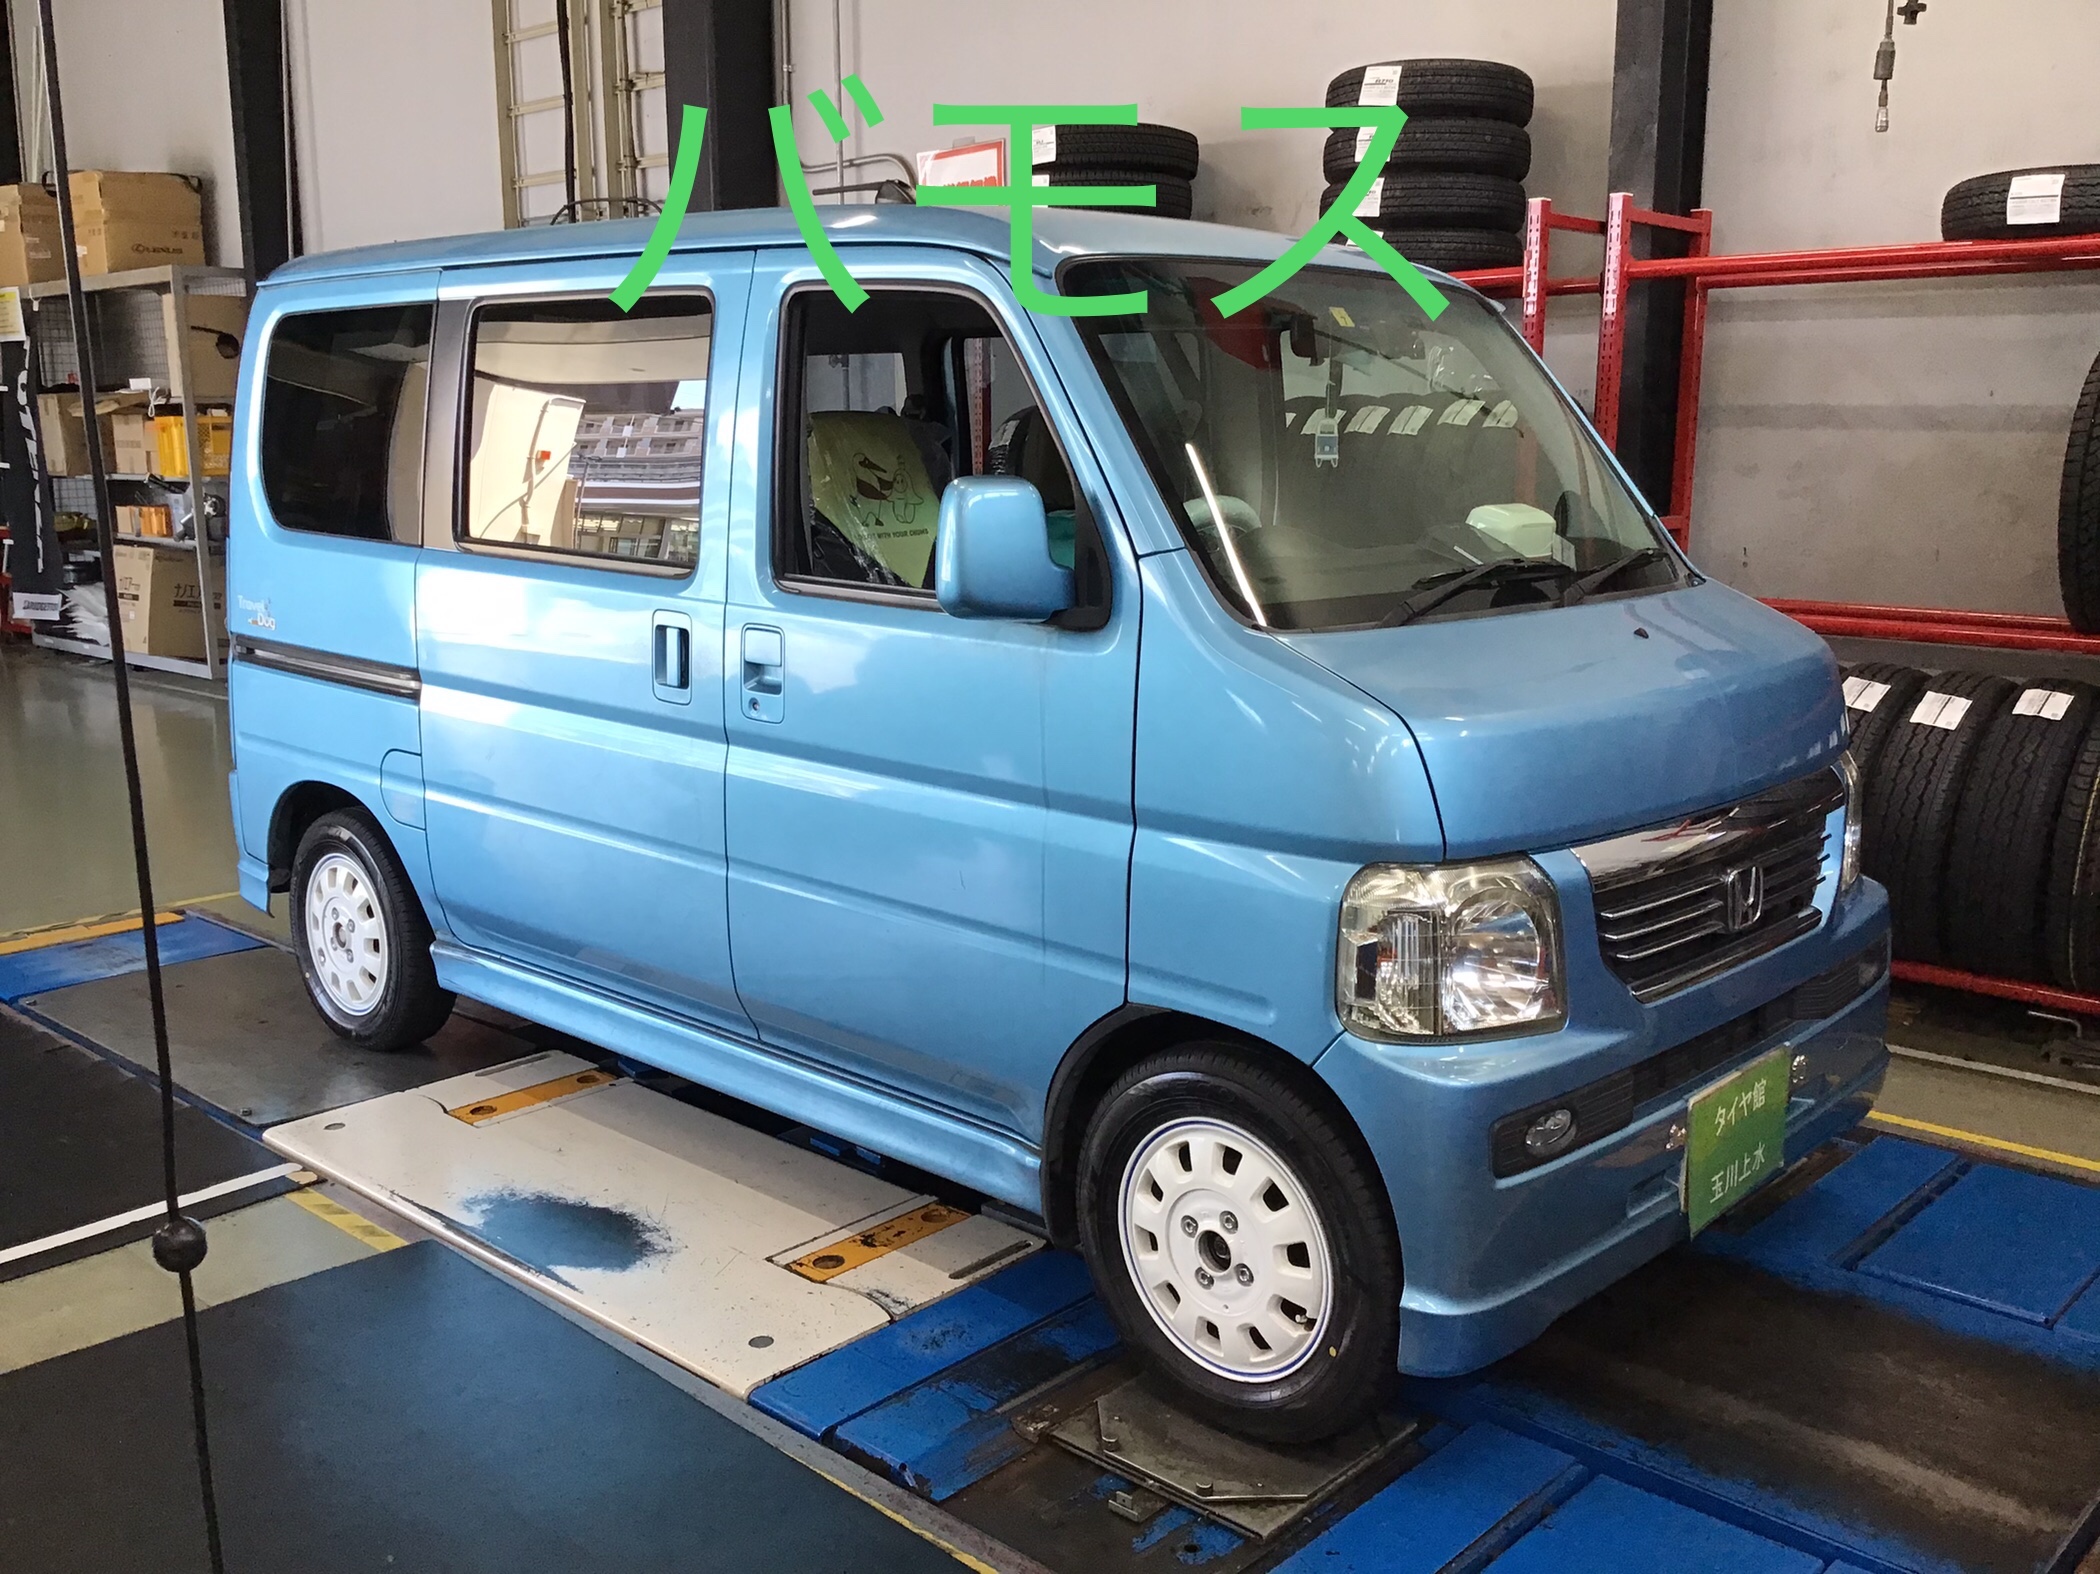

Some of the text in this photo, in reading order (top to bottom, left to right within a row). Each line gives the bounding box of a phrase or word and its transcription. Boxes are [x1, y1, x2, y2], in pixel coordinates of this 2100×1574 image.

[237, 594, 266, 613] Travel
[257, 612, 276, 631] Dog
[1714, 1077, 1767, 1137] タイヤ館
[1709, 1141, 1766, 1204] 玉川上水
